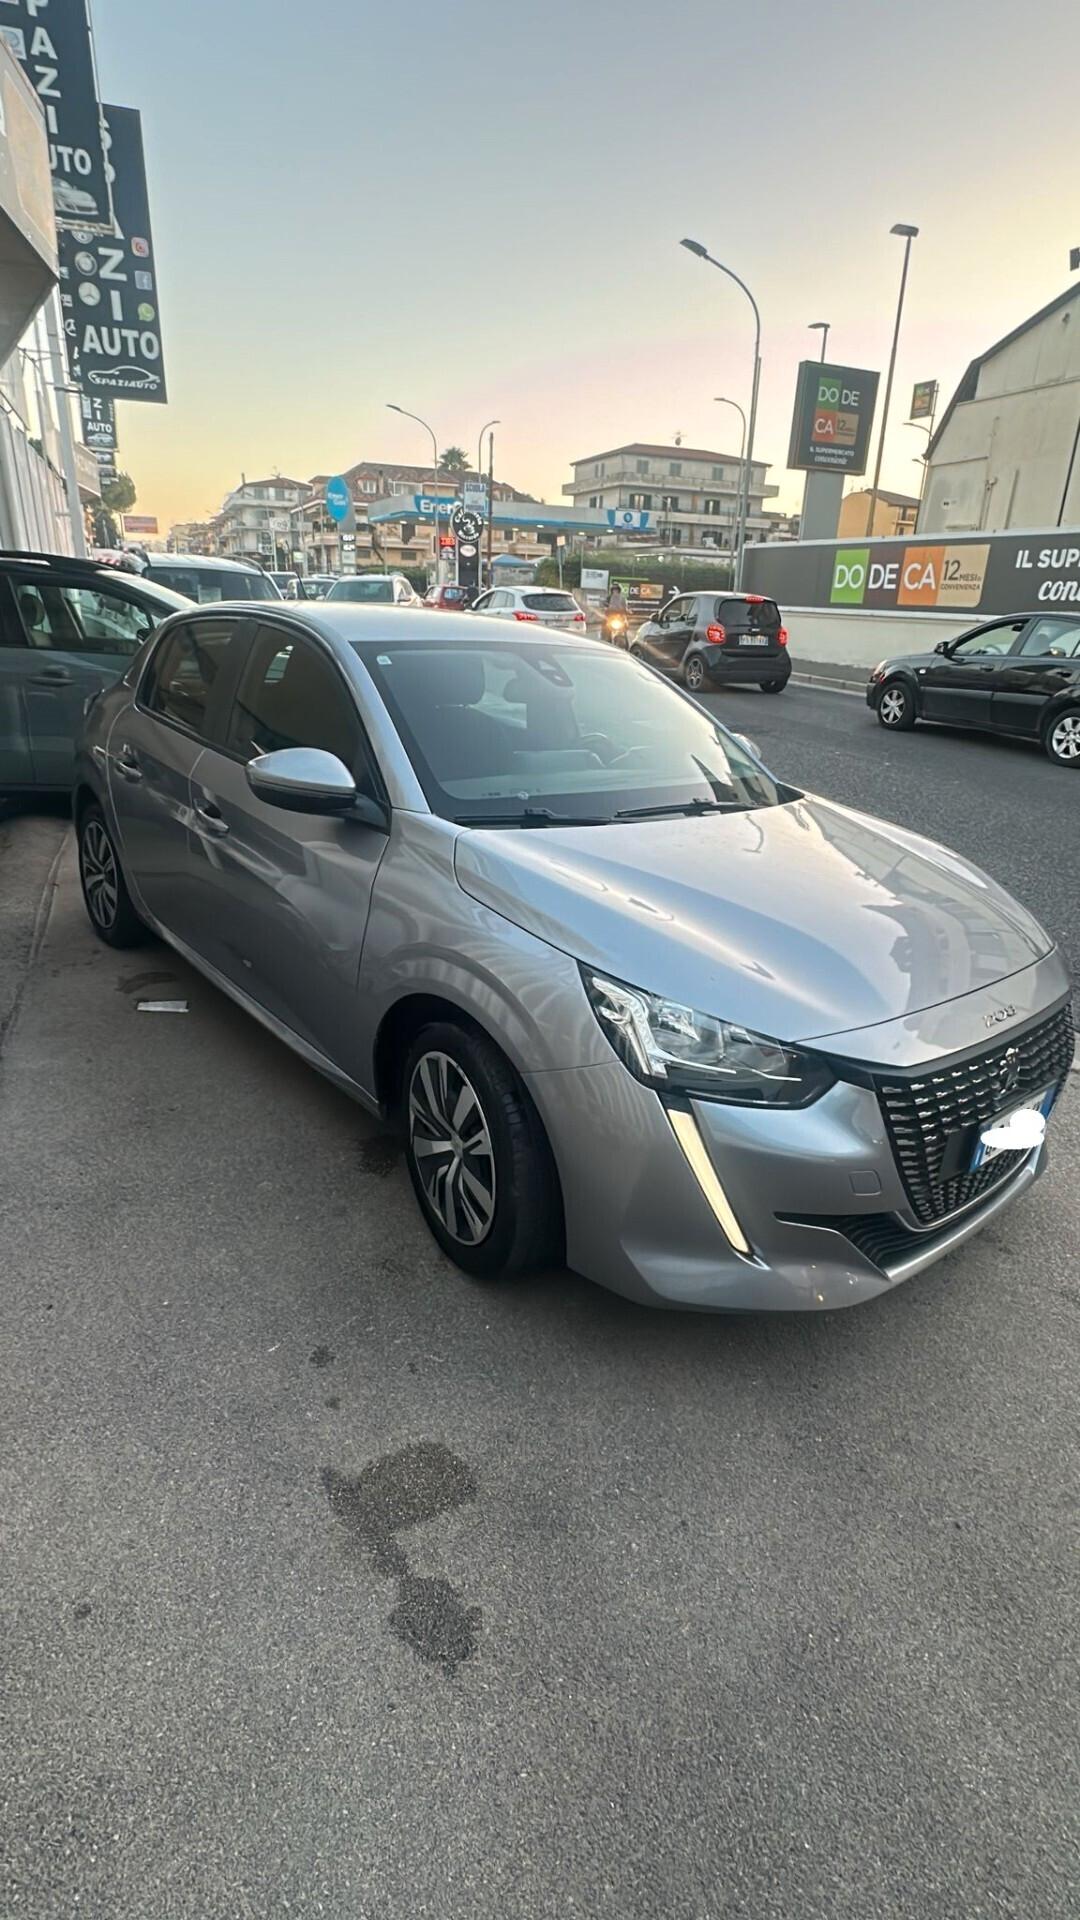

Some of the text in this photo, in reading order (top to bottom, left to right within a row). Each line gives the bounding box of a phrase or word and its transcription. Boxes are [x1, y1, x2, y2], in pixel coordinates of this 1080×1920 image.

[50, 144, 92, 176] UTO
[82, 325, 160, 361] AUTO
[95, 377, 158, 391] SPAZIAUTO
[818, 386, 860, 406] DO DE
[87, 421, 113, 434] AUTO
[814, 418, 834, 435] CA
[1015, 548, 1080, 568] IL SUP
[834, 562, 937, 591] DO DE CA
[943, 559, 961, 581] 12
[1038, 580, 1080, 601] con
